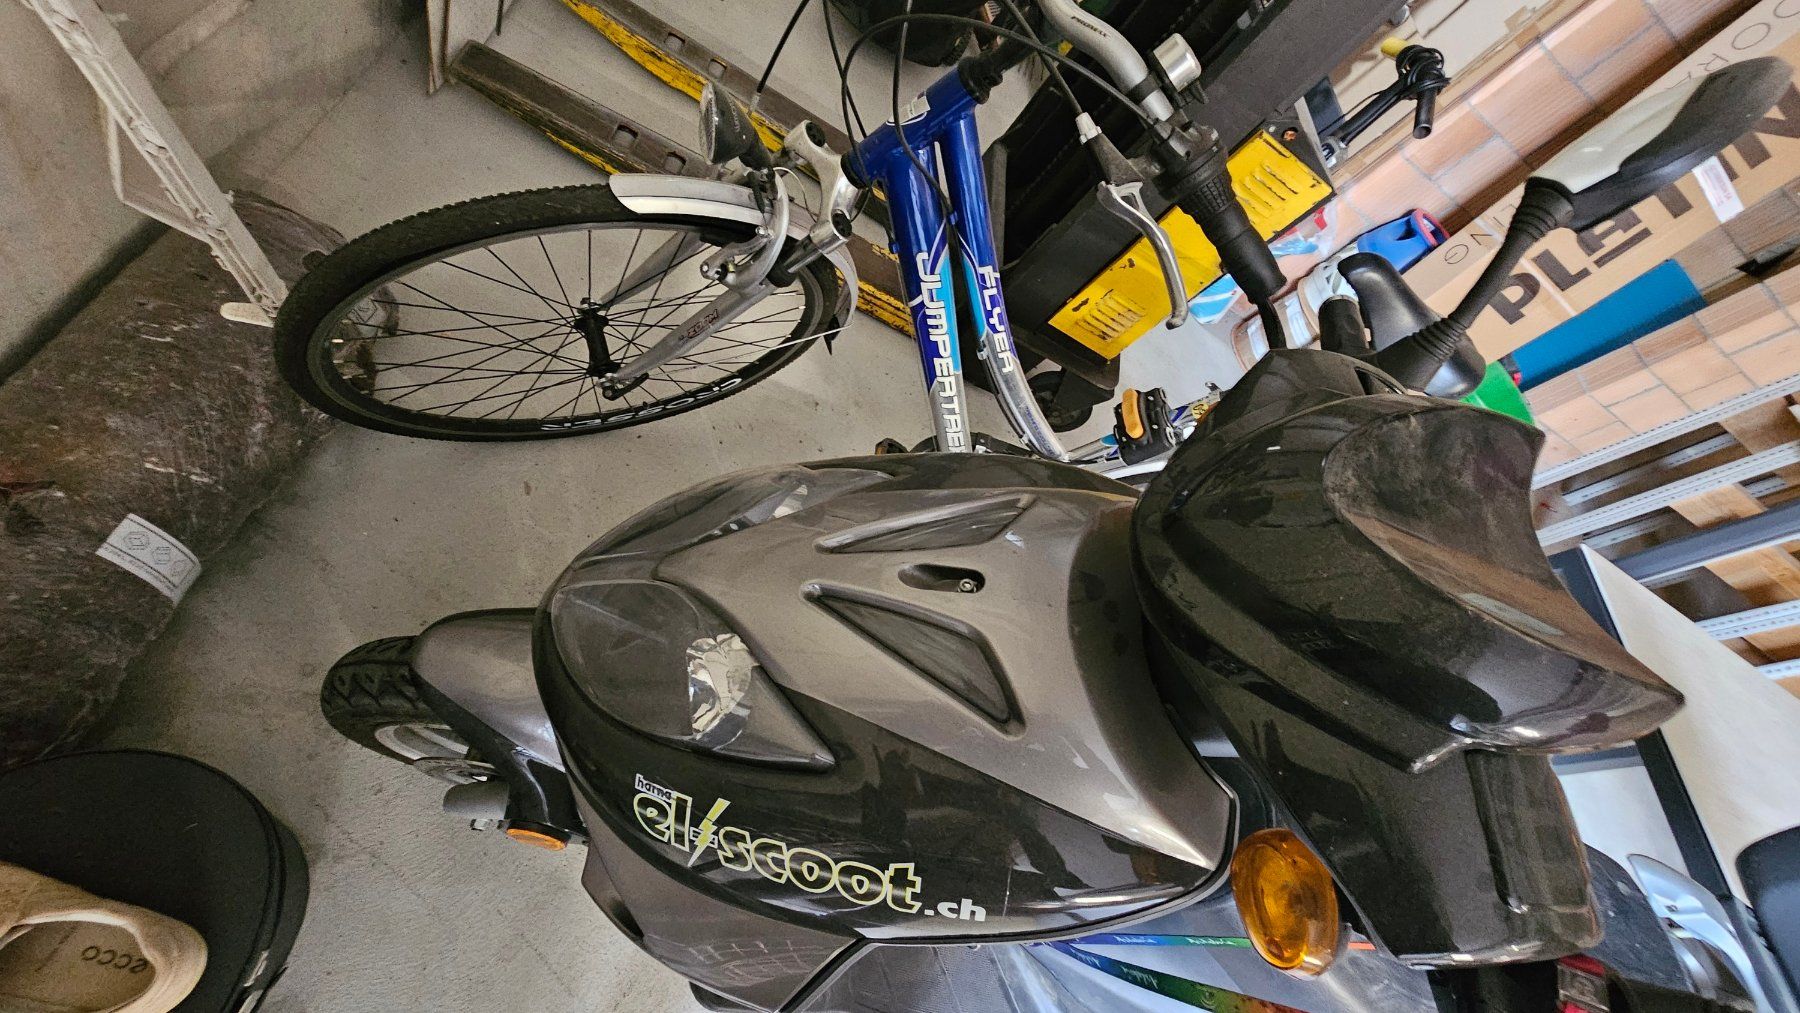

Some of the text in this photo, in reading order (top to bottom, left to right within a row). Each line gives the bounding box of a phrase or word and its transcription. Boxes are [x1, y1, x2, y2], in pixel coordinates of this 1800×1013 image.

[915, 252, 968, 454] JUMPERTRE
[978, 265, 1014, 373] FLYER
[81, 945, 149, 974] ecco
